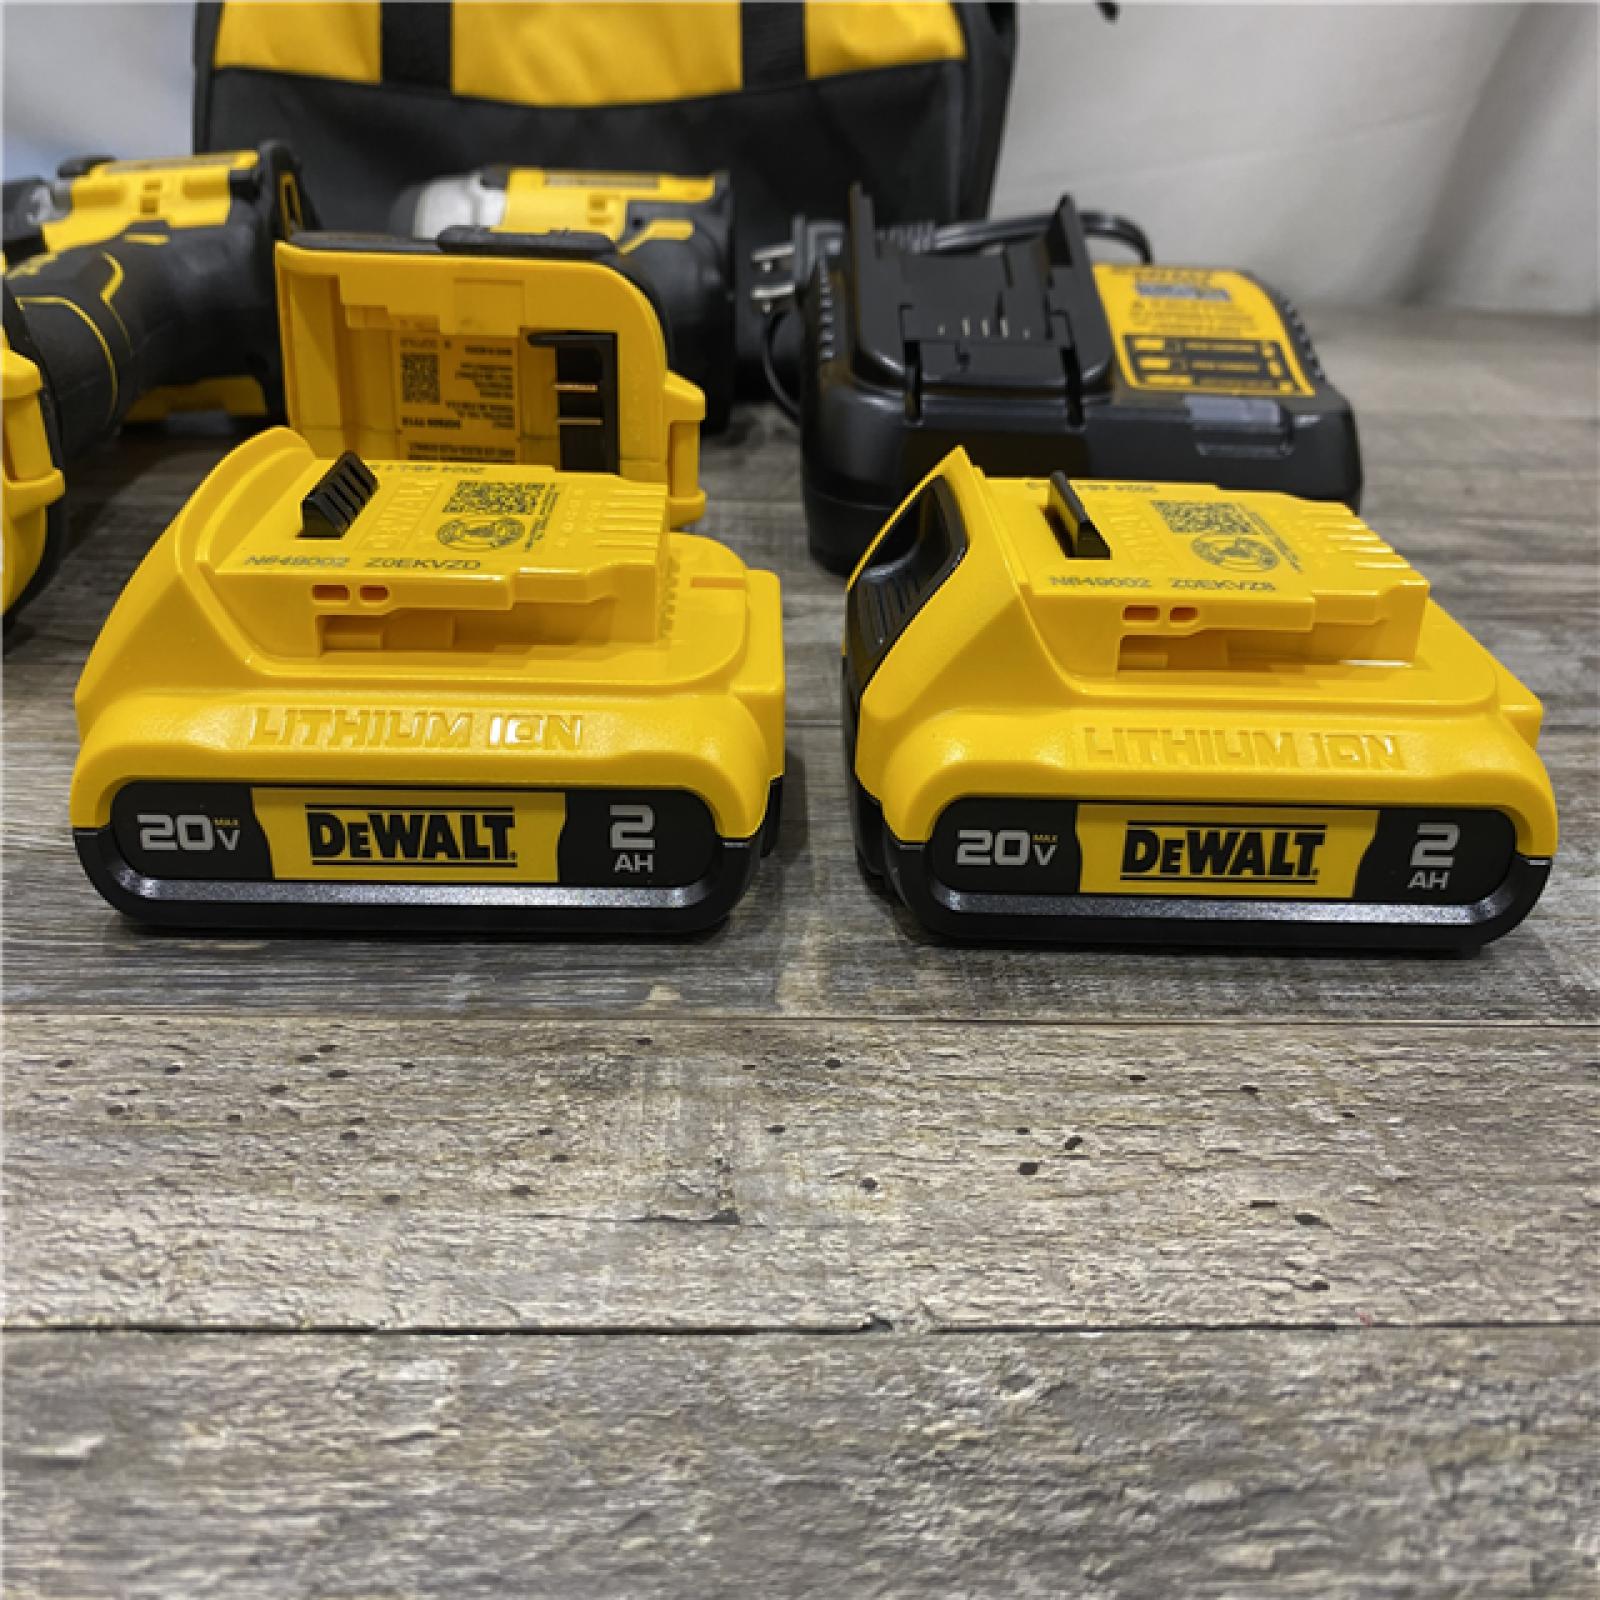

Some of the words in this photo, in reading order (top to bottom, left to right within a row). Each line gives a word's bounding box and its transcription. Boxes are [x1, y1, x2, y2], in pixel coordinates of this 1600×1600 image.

[249, 708, 472, 748] LITHIUM
[488, 713, 583, 751] ION
[1080, 727, 1300, 768] LITHIUM
[1309, 731, 1406, 771] ION
[609, 804, 656, 850] 2
[1411, 823, 1460, 868] 2
[614, 854, 653, 873] AH
[1407, 871, 1449, 890] AH
